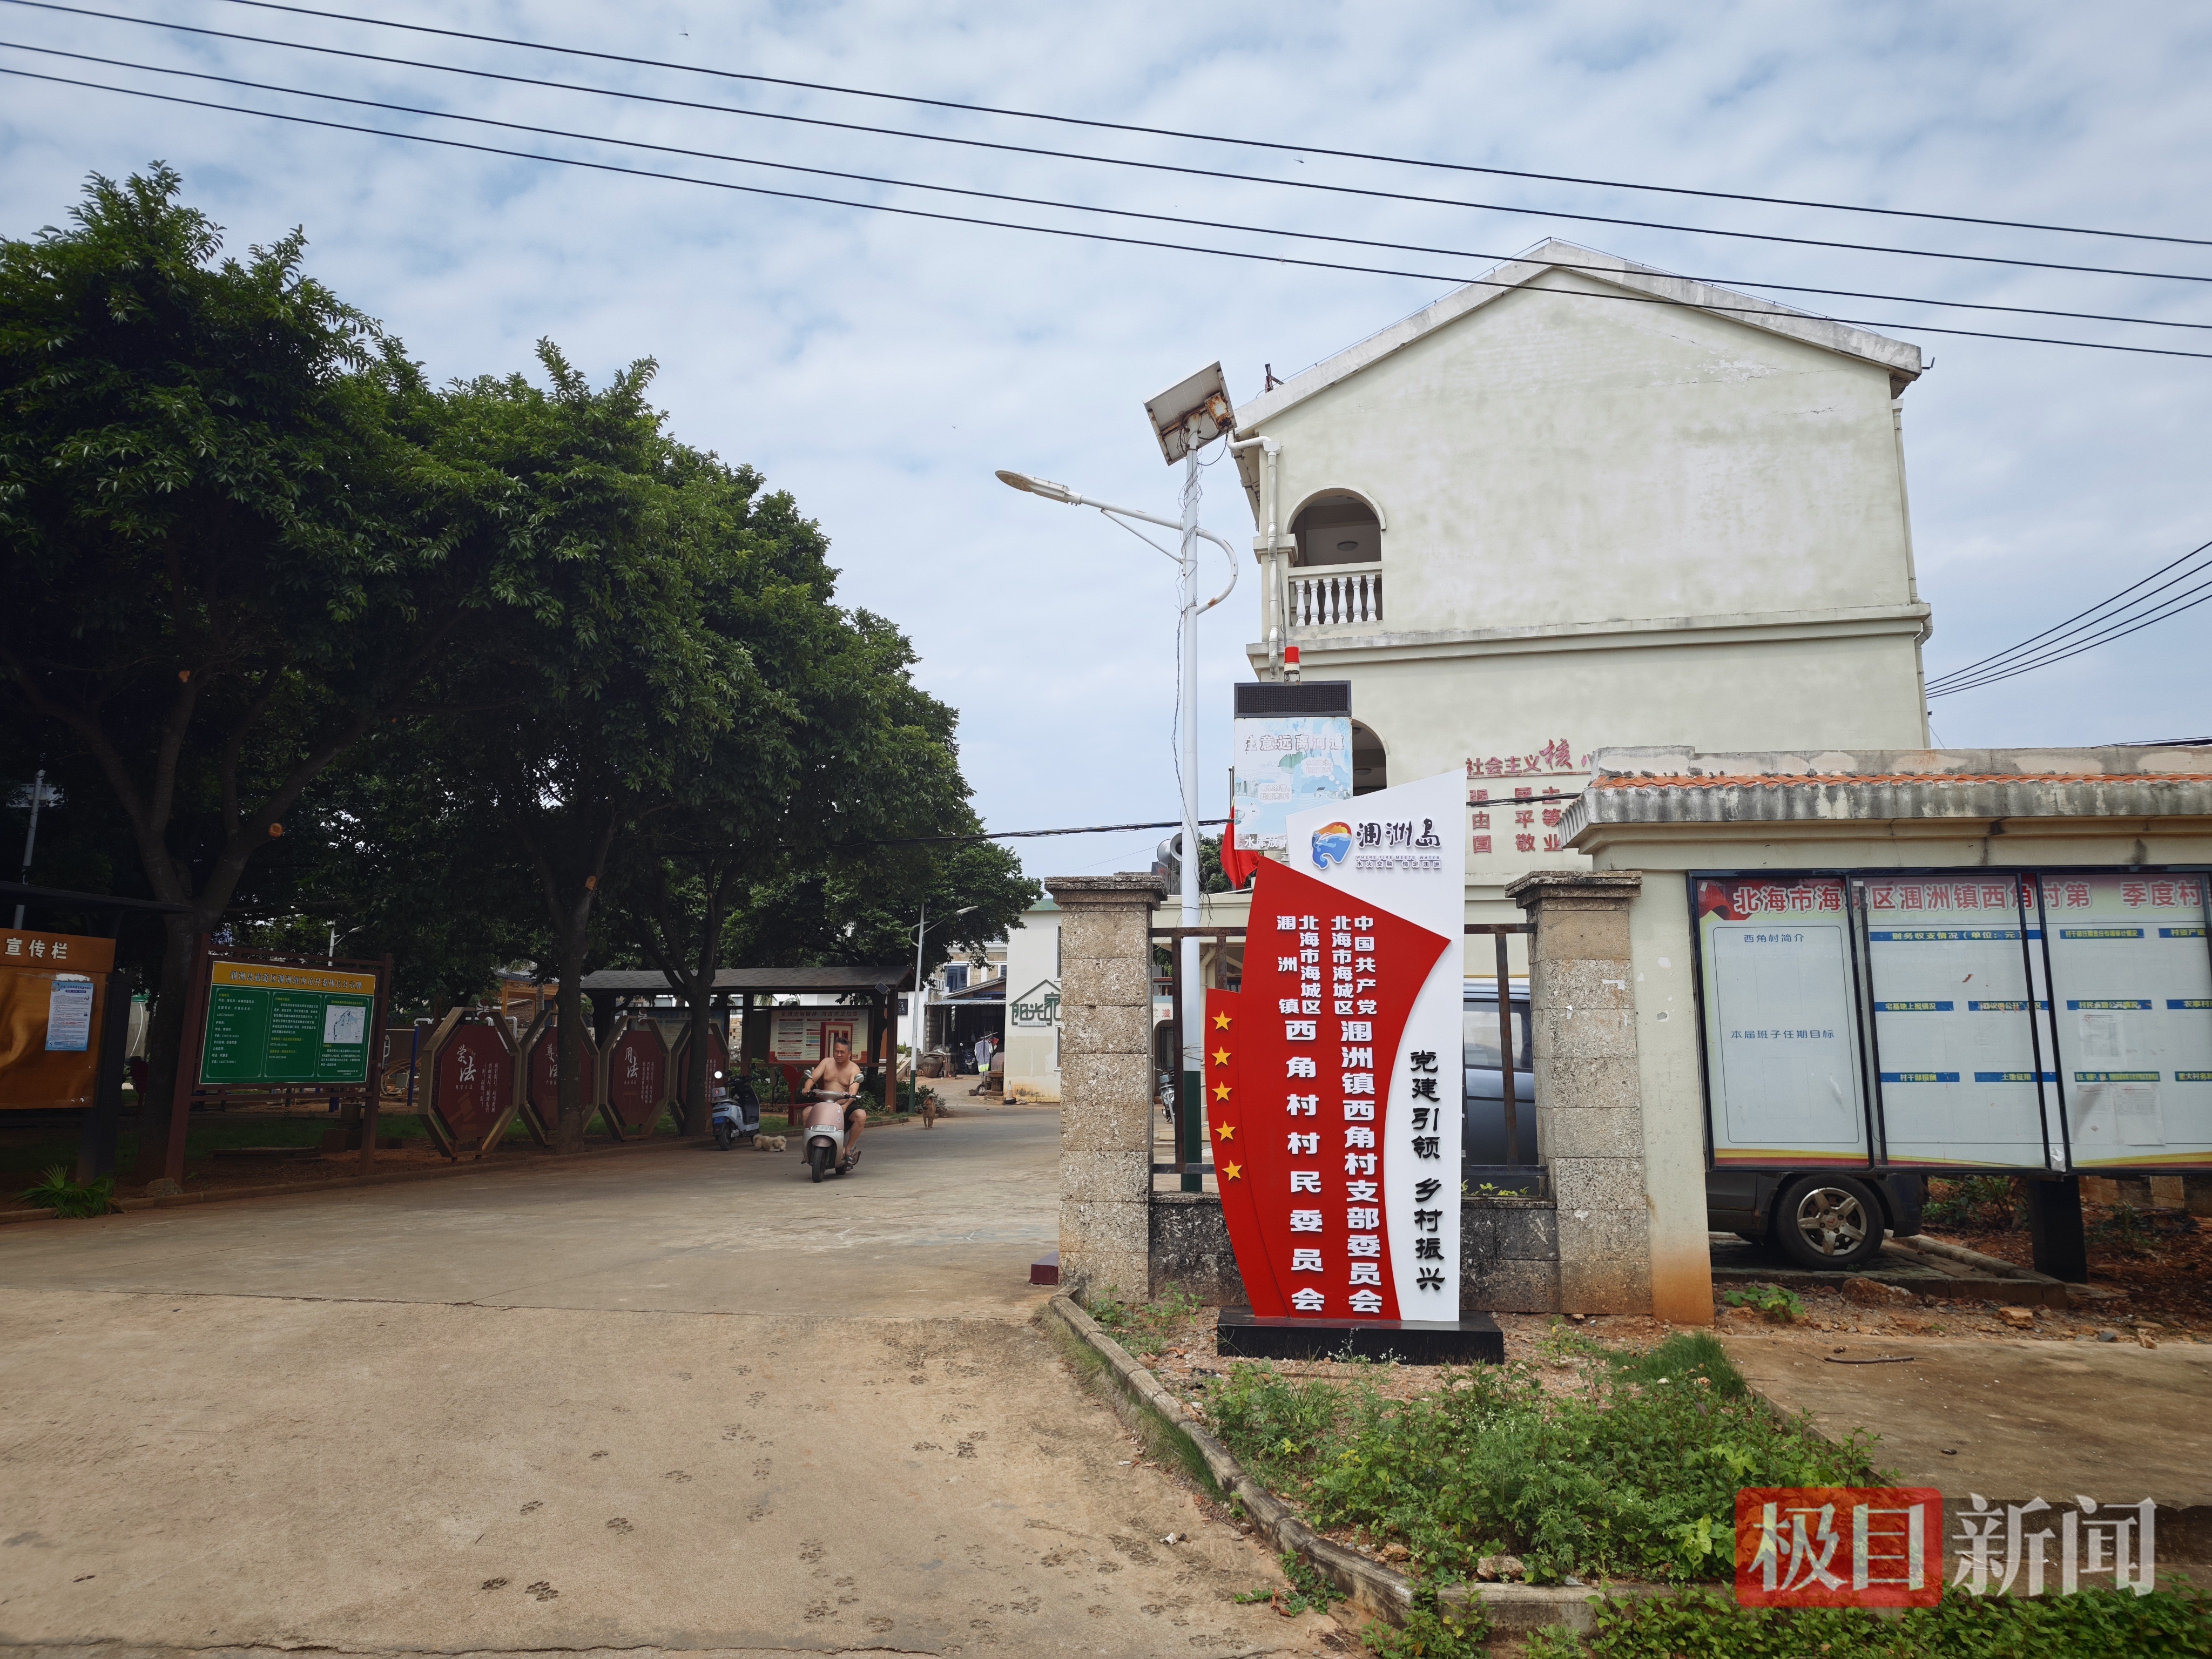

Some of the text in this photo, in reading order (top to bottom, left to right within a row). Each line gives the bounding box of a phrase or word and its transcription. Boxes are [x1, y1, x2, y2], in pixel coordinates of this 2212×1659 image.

[1357, 818, 1440, 847] 涠洲岛
[1472, 808, 1561, 830] 由 平等
[1473, 833, 1563, 853] 国 敬业
[2122, 881, 2212, 908] 季度村
[5, 938, 68, 959] 宣传栏
[1744, 934, 1804, 942] 西角村简介
[1277, 915, 1299, 1014] 涠洲镇
[1299, 915, 1321, 1015] 北海市海城区
[1331, 915, 1353, 1015] 北海市海城区
[1354, 915, 1377, 1015] 中国共产党
[1731, 1030, 1835, 1038] 本届班子任期目标
[457, 1044, 476, 1082] 学法
[625, 1047, 639, 1078] 用法
[1285, 1021, 1324, 1311] 西角村村民委员会
[1341, 1021, 1382, 1313] 涠洲镇西角村支部委员会
[1410, 1050, 1445, 1291] 党建引领 乡村振兴
